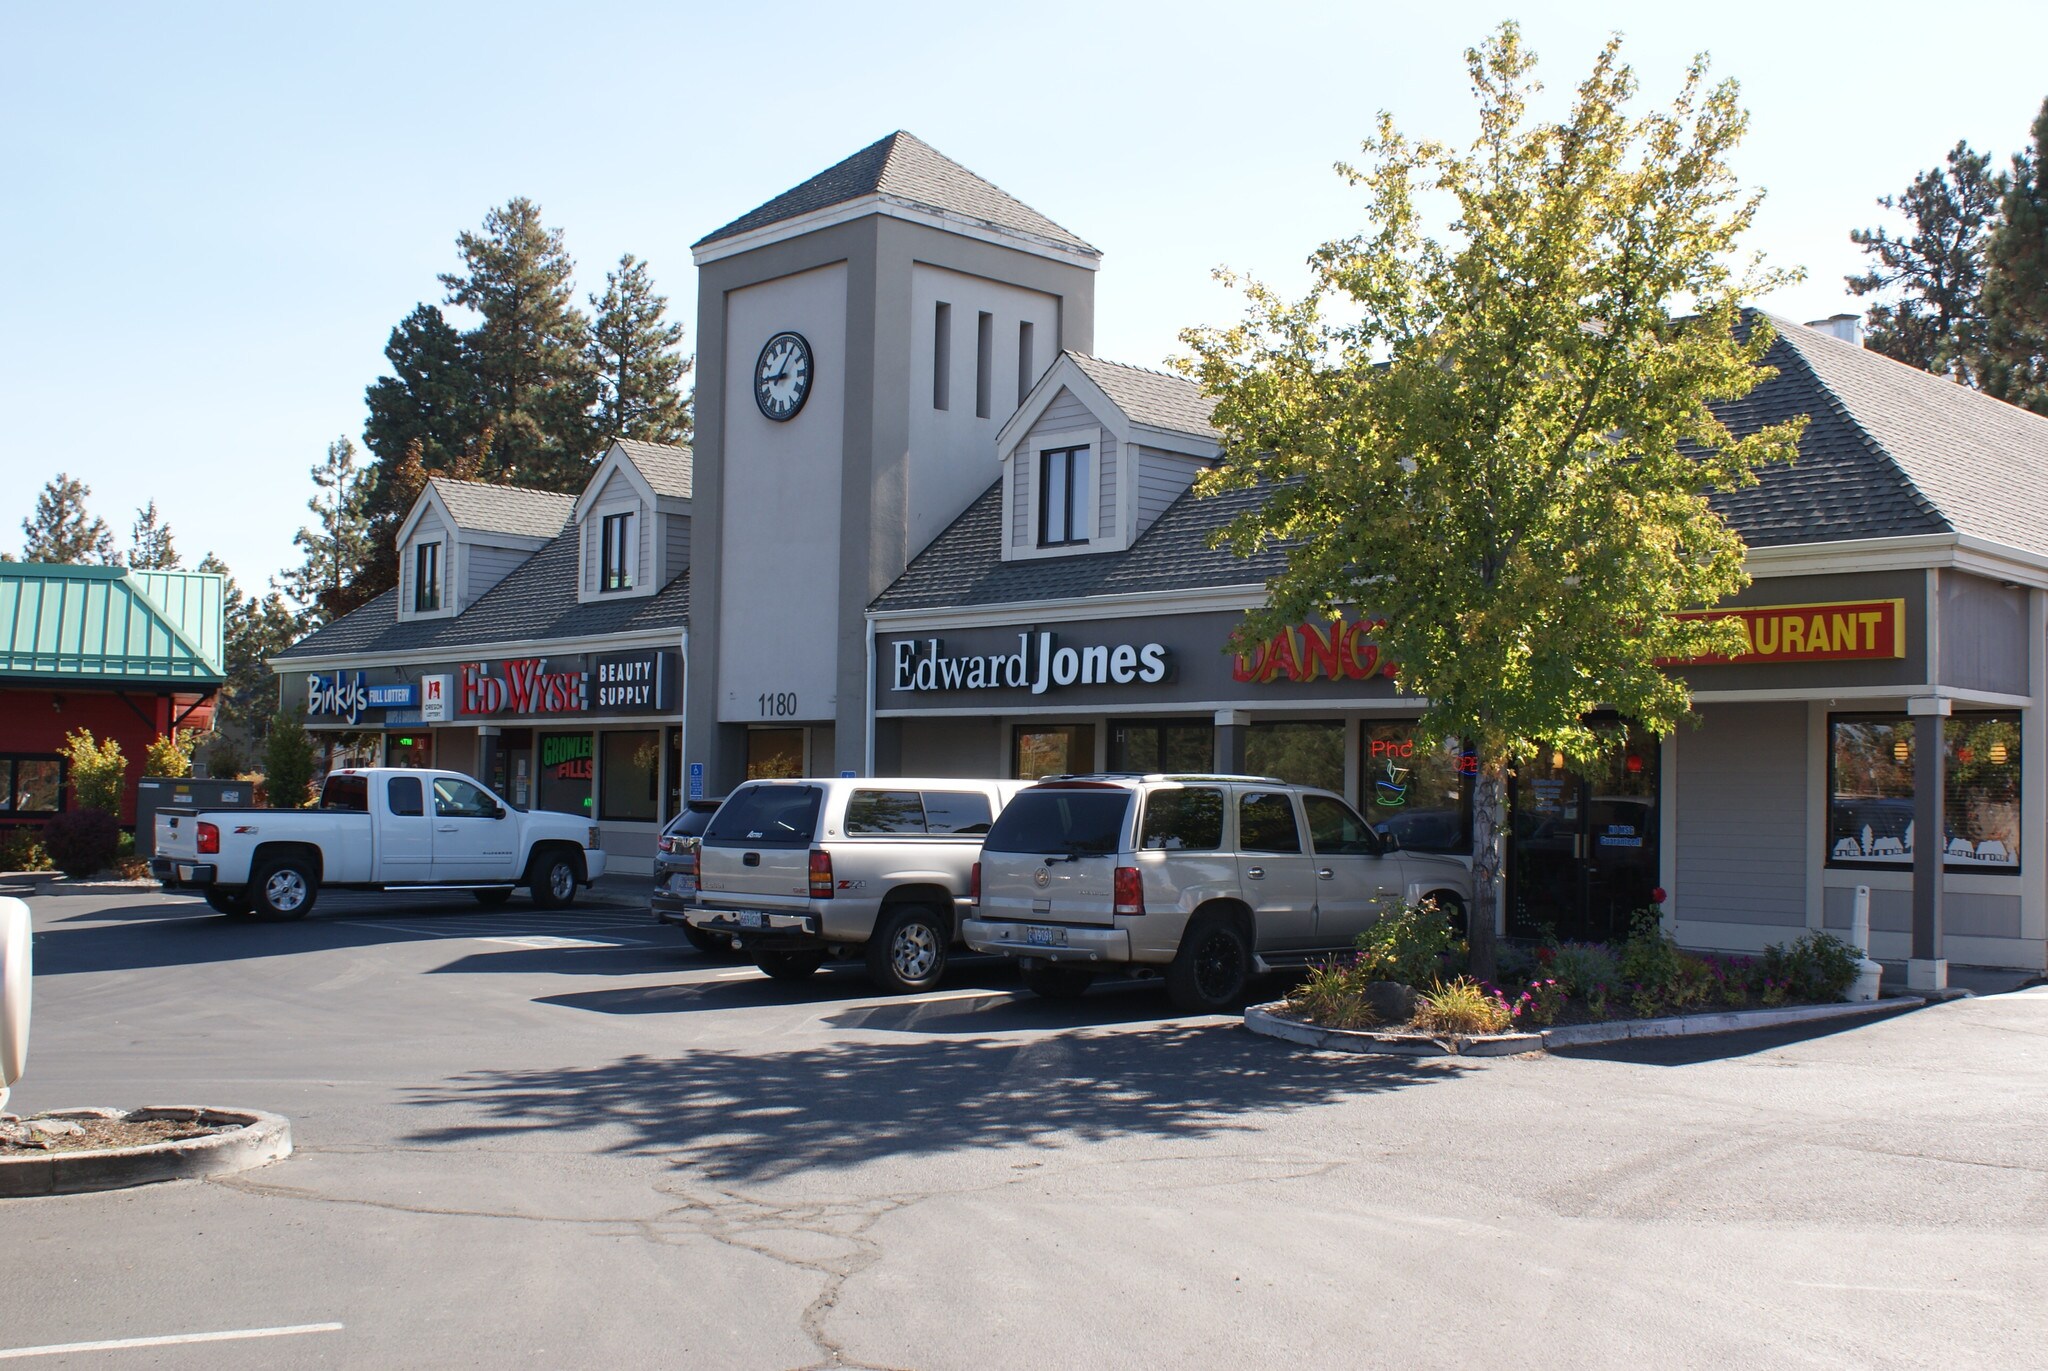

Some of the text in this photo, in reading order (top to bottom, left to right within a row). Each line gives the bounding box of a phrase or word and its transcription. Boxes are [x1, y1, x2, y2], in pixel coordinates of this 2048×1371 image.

[600, 661, 651, 683] BEAUTY
[891, 631, 1166, 695] Edward Jones
[307, 671, 367, 725] Binky's
[384, 688, 410, 702] LOTTERY
[600, 685, 650, 706] SUPPLY
[758, 692, 797, 716] 1180
[1453, 756, 1477, 772] OPE
